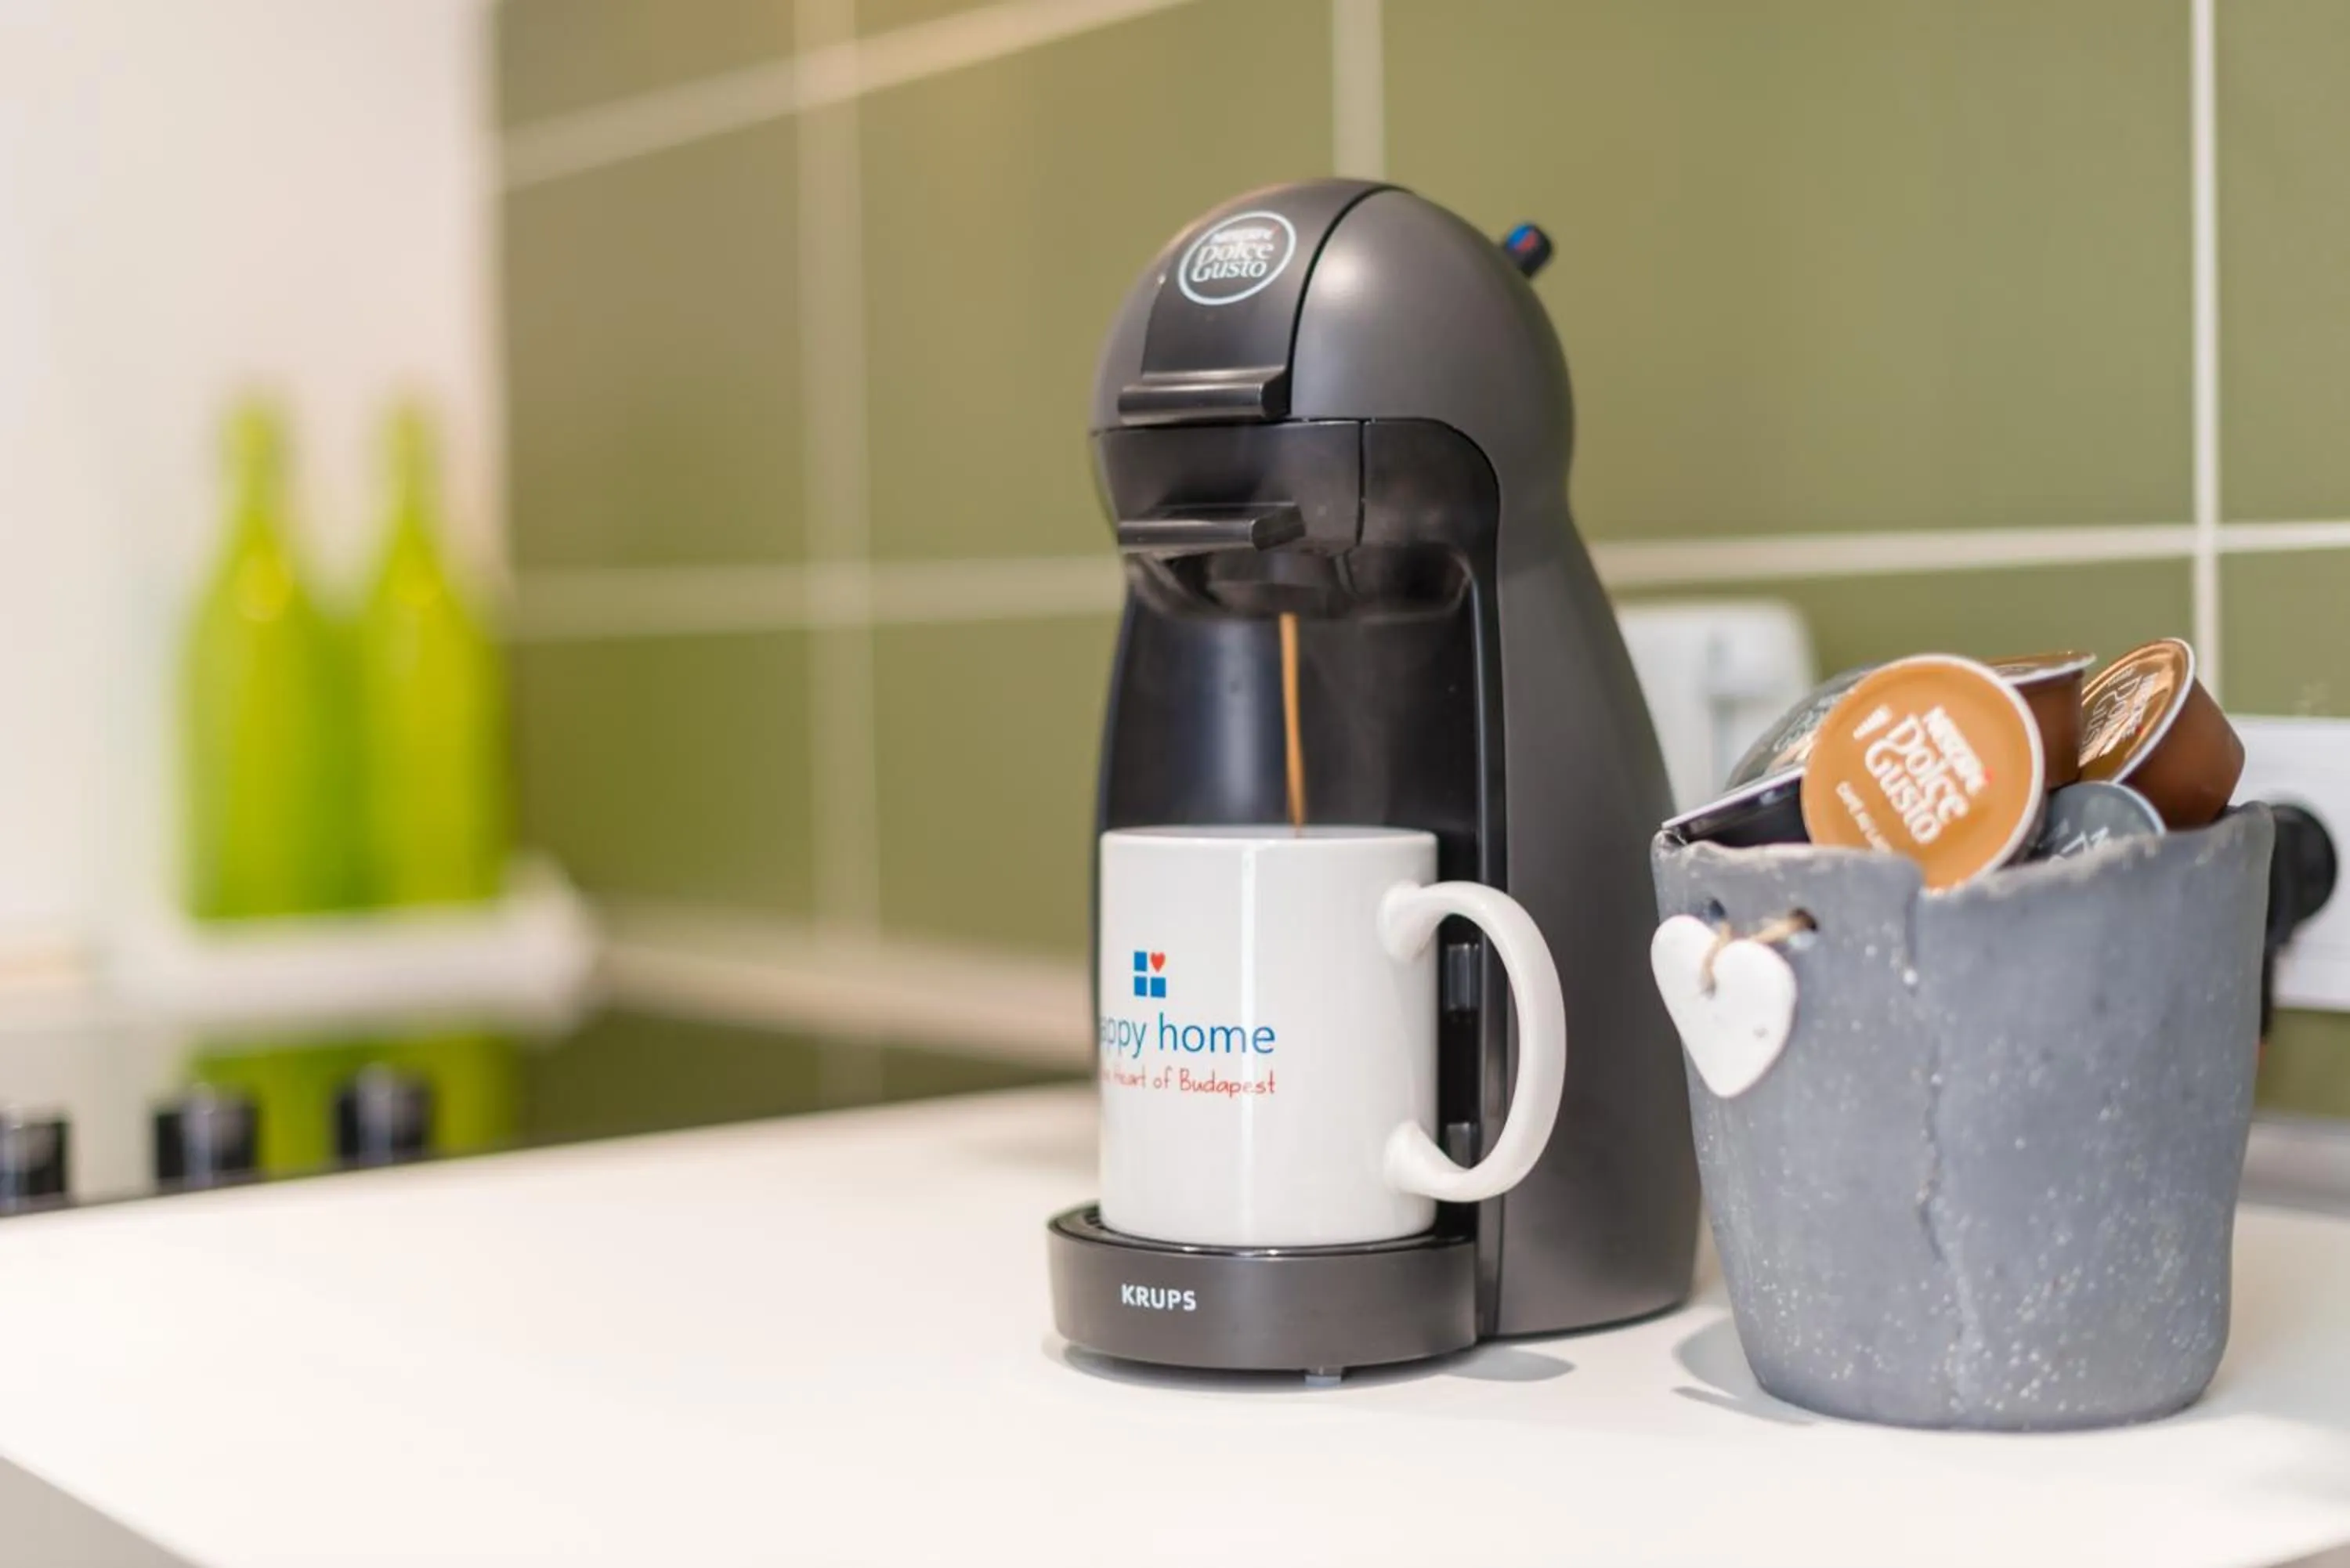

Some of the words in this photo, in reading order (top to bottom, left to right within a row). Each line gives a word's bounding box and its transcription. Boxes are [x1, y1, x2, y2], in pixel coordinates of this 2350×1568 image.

[1197, 239, 1274, 265] Dolce
[1191, 260, 1267, 283] Gusto
[1884, 713, 1969, 826] Dolce
[1864, 738, 1942, 844] Gusto
[1159, 1011, 1275, 1054] home
[1153, 1065, 1173, 1090] of
[1179, 1067, 1275, 1098] Budapest
[1121, 1283, 1197, 1311] KRUPS
